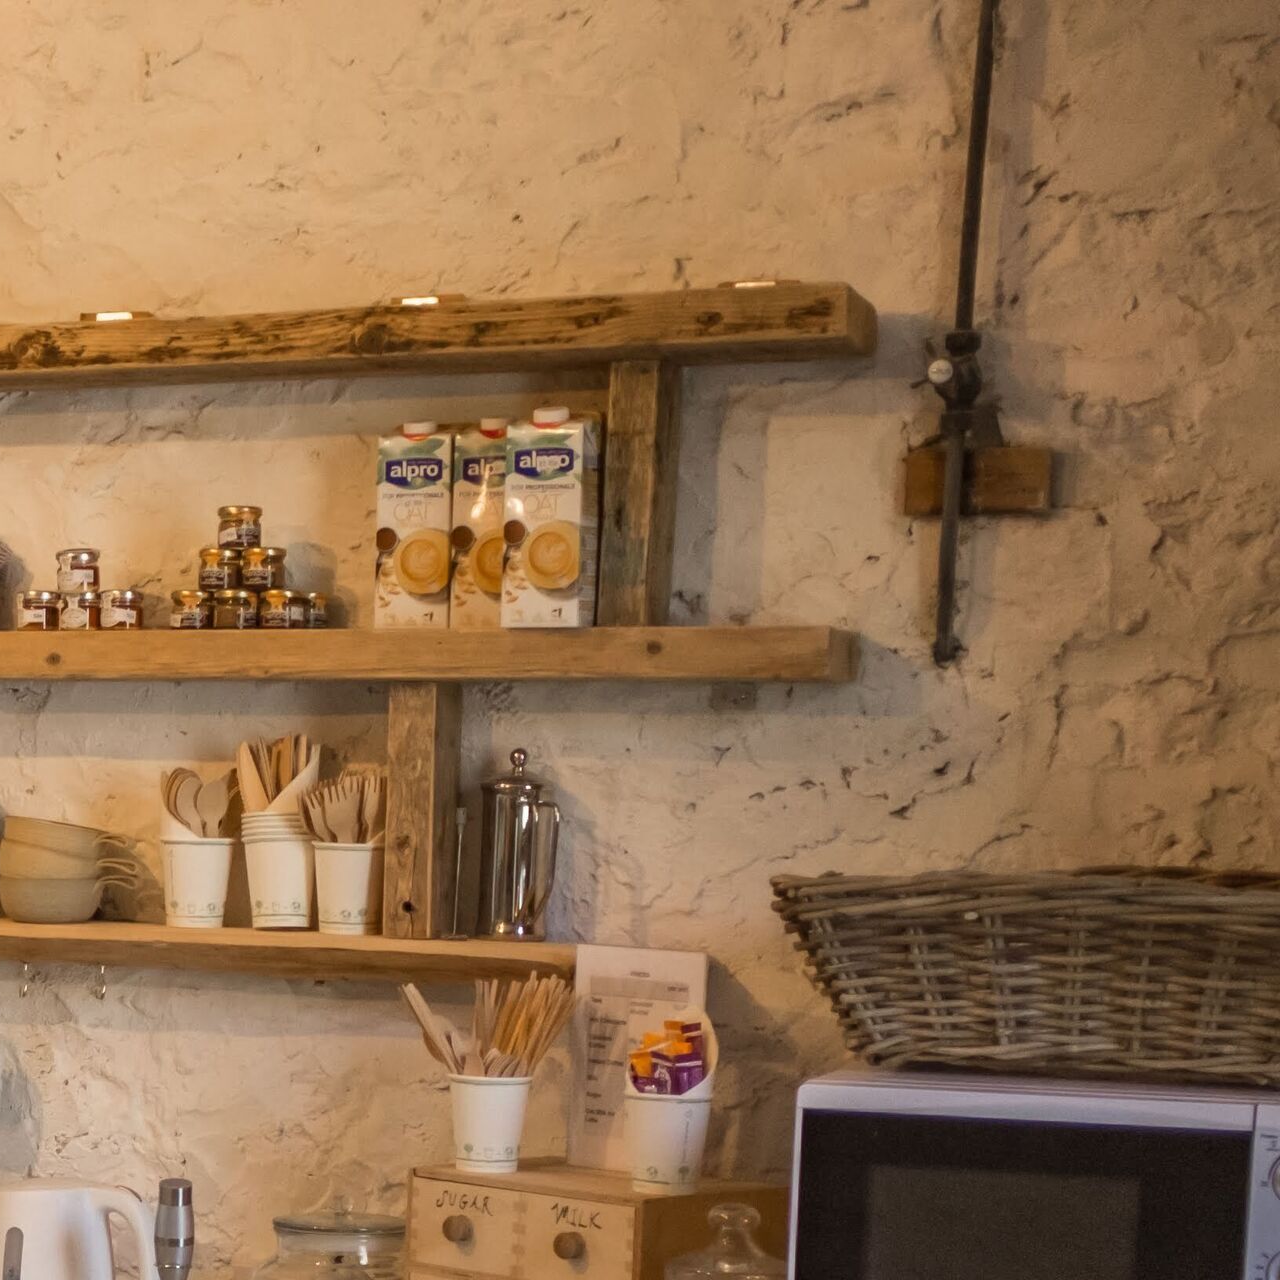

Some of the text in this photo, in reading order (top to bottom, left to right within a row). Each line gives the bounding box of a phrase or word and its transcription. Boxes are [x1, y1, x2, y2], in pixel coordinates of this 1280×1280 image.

[390, 461, 439, 482] alpro
[436, 1191, 493, 1217] SUGAR
[550, 1203, 602, 1230] MILK
